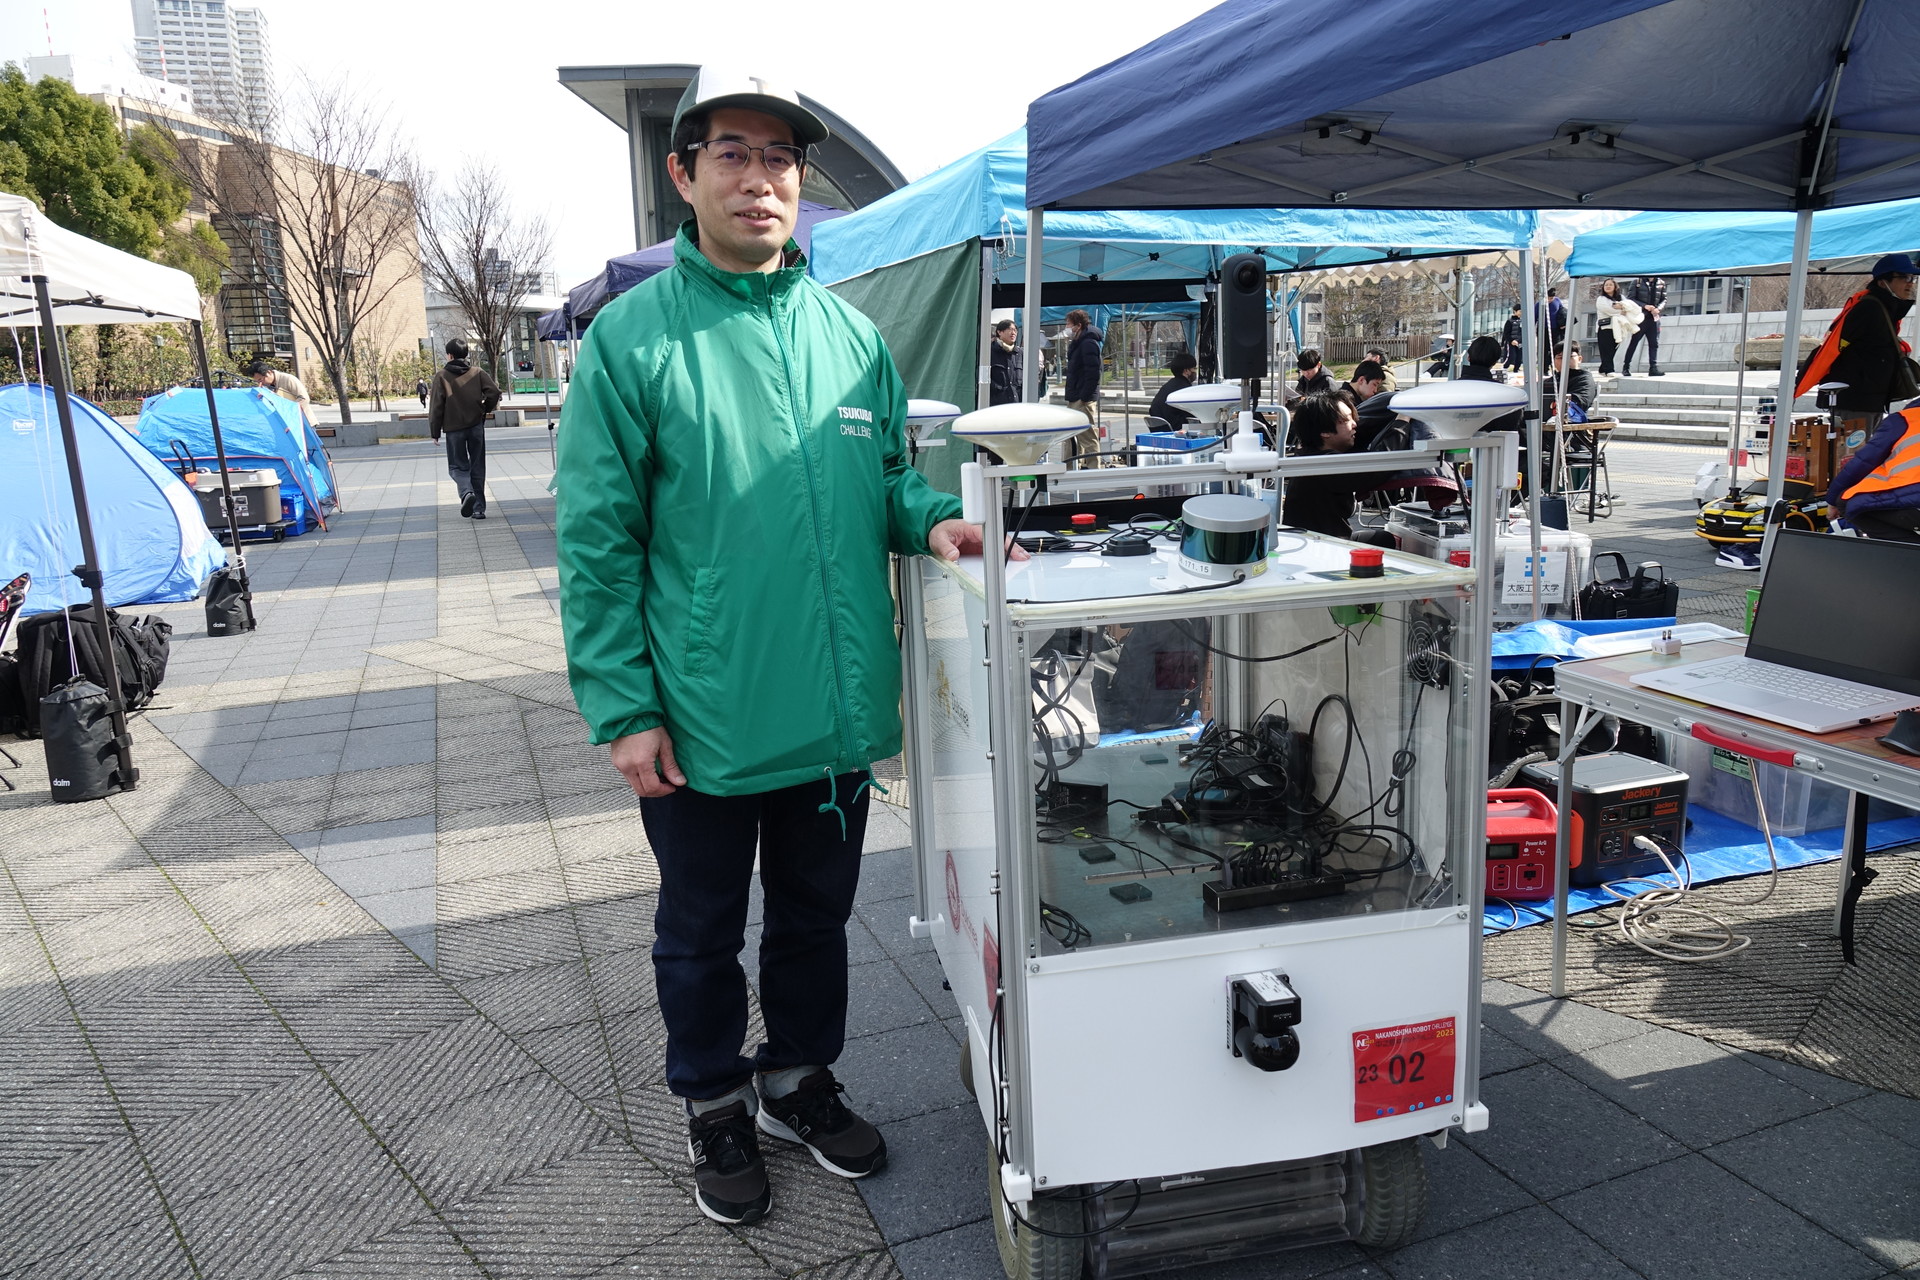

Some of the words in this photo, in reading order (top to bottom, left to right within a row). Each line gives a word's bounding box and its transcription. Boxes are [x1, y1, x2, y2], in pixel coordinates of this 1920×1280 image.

[837, 406, 873, 423] TSUKUBA
[1507, 584, 1560, 593] 大阪工大学
[1622, 786, 1662, 800] Jackery
[1375, 1027, 1412, 1040] NAKANOSHIMA
[1412, 1024, 1432, 1034] ROBOT
[1431, 1020, 1453, 1031] CHALLENGE
[1436, 1028, 1454, 1038] 2023
[1358, 1064, 1379, 1084] 23
[1388, 1051, 1425, 1085] 02
